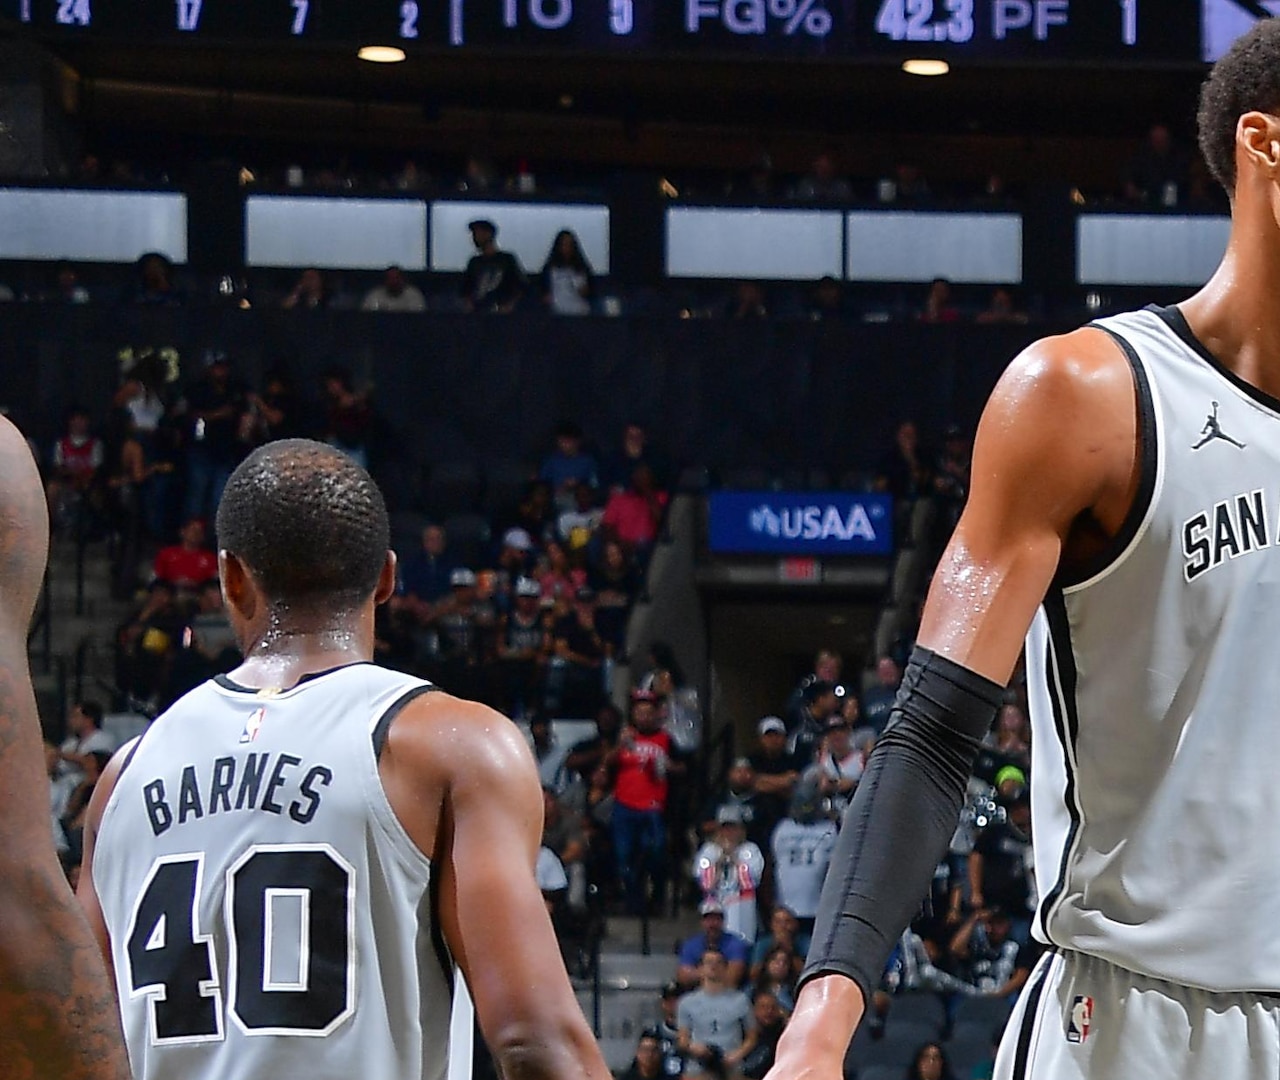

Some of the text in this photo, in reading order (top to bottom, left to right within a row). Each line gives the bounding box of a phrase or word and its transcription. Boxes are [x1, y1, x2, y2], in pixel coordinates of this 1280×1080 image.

[400, 0, 418, 38] 2
[685, 0, 832, 34] FG%
[875, 0, 974, 42] 42.3
[992, 0, 1069, 41] PF
[782, 504, 876, 541] USAA
[1182, 489, 1270, 584] SAN
[142, 751, 334, 837] BARNES
[123, 843, 356, 1046] 40
